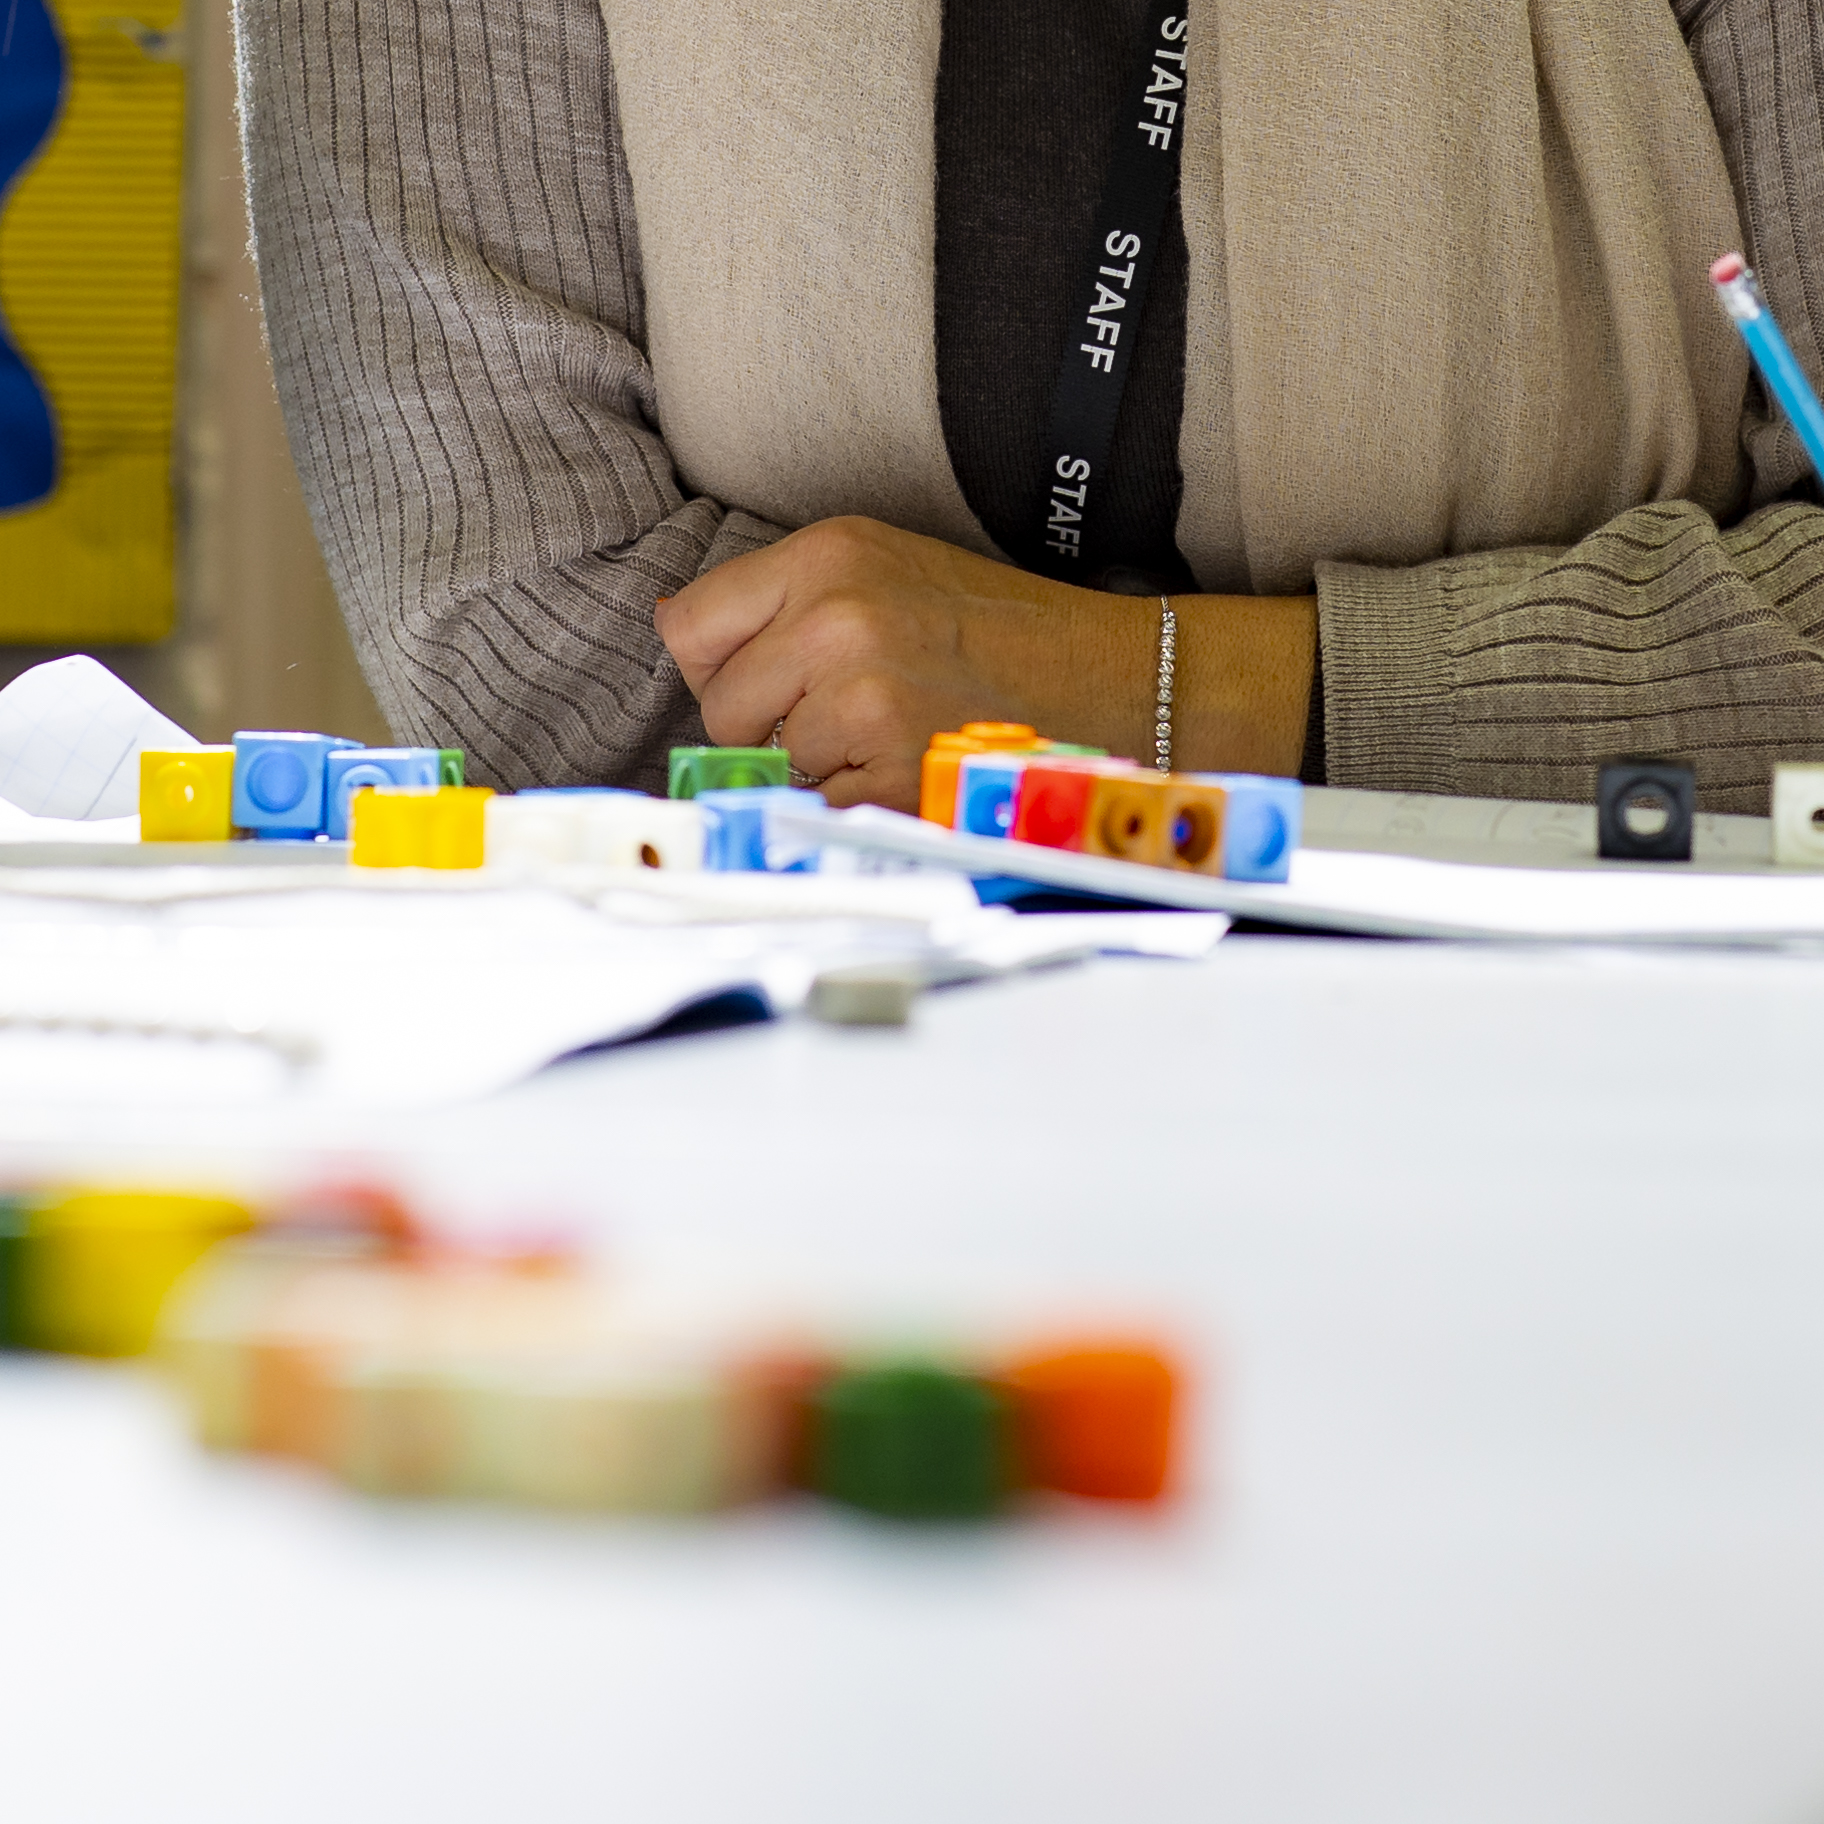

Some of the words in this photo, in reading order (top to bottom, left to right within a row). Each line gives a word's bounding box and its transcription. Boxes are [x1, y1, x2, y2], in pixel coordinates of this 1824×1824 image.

[1137, 15, 1190, 152] STAFF
[1079, 229, 1141, 374] STAFF
[1044, 453, 1091, 559] STAFF
